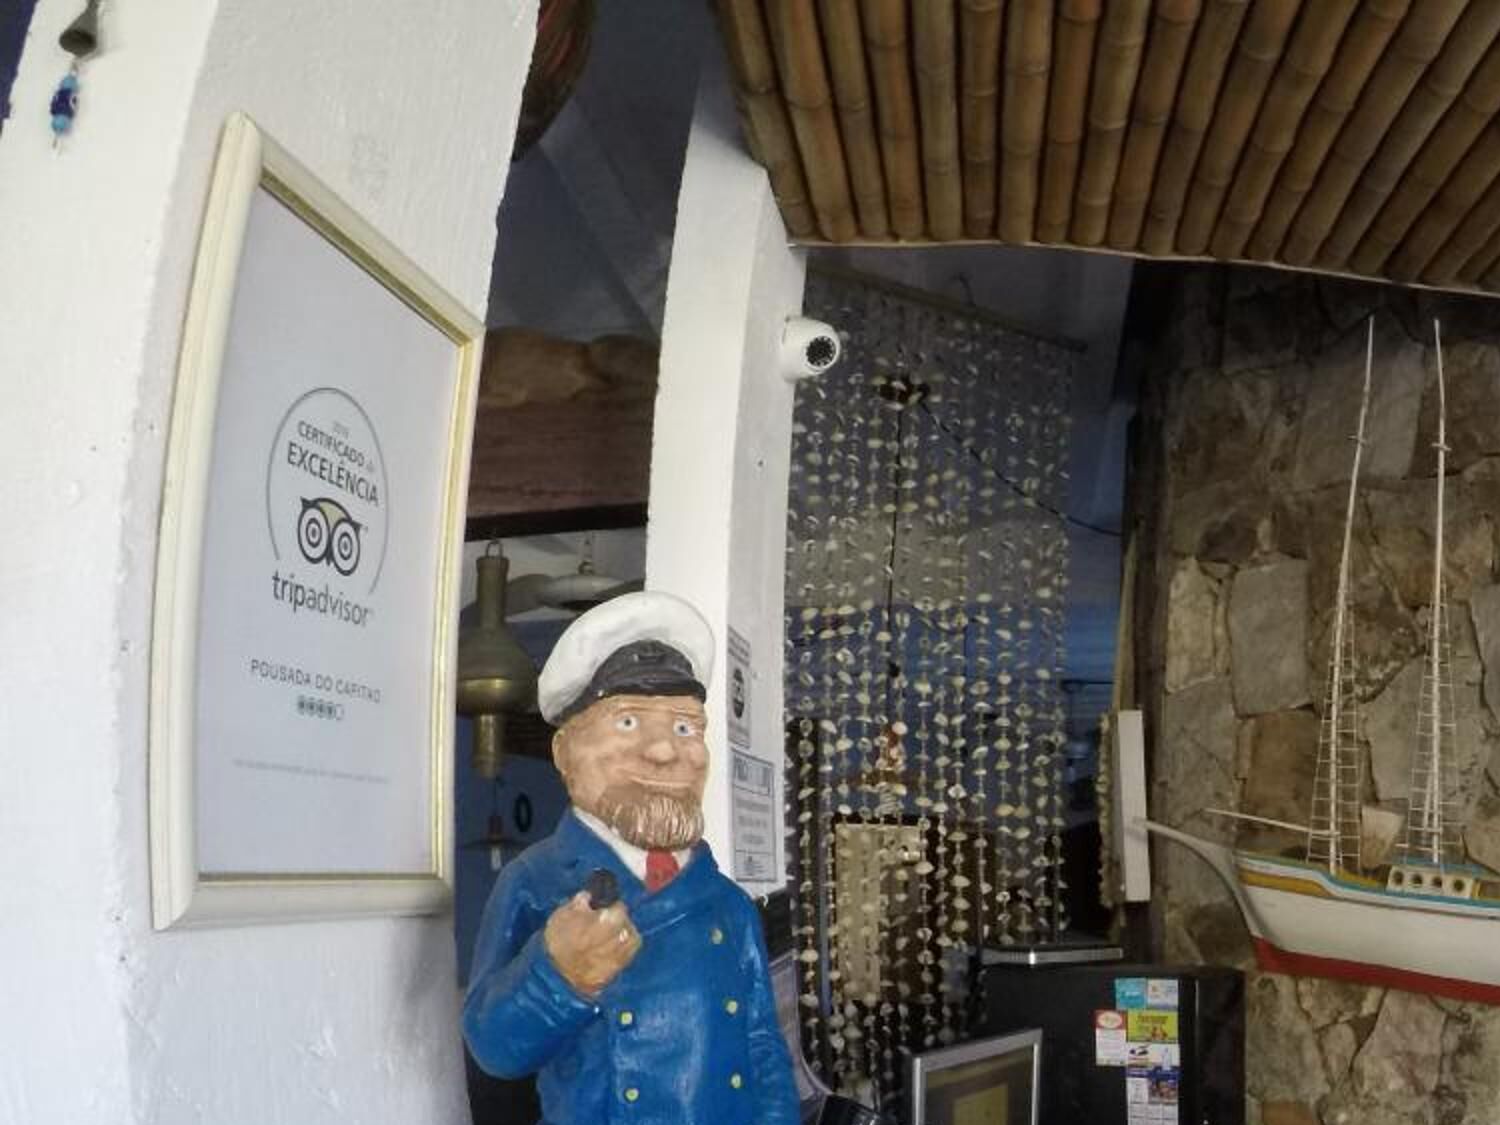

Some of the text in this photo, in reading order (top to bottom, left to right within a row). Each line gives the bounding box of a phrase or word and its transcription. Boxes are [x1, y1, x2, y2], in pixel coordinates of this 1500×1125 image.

[298, 420, 364, 467] CERTIFICADO
[272, 570, 368, 627] tripadvisor
[251, 659, 311, 685] POUSADA
[315, 673, 333, 692] DO
